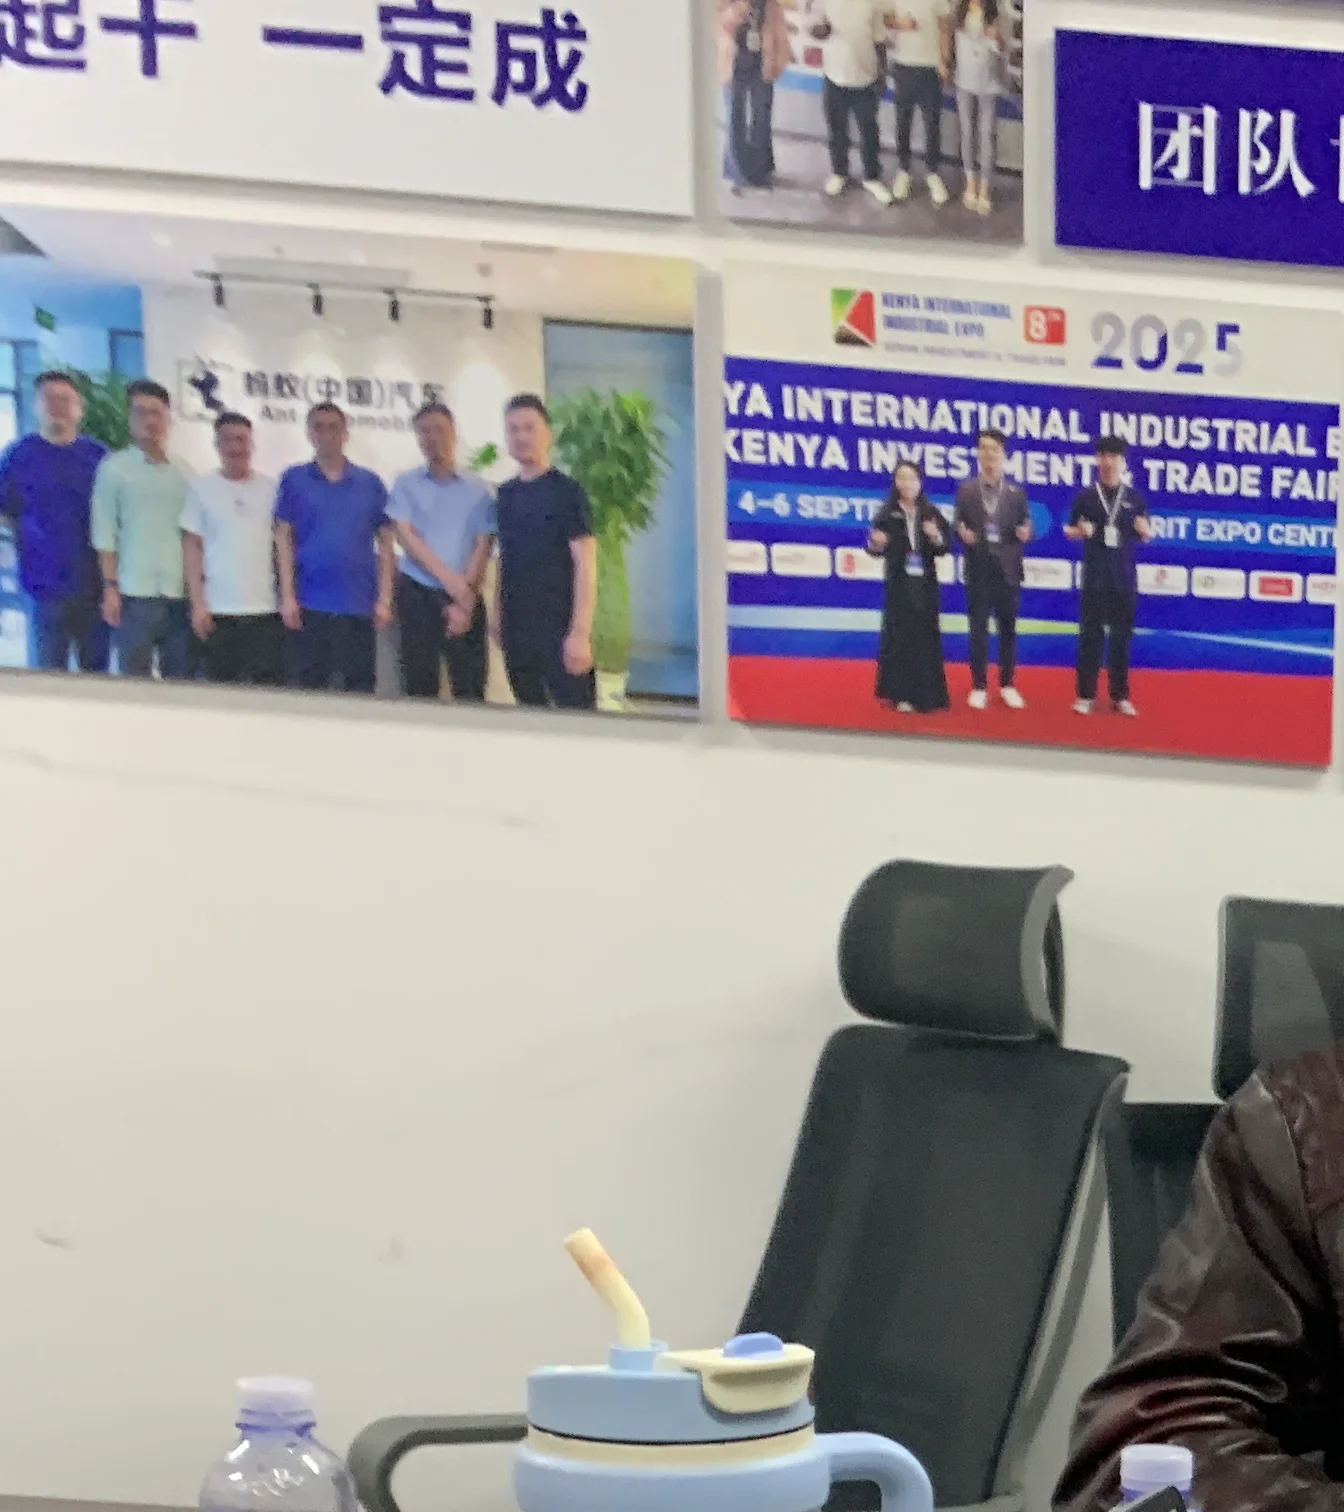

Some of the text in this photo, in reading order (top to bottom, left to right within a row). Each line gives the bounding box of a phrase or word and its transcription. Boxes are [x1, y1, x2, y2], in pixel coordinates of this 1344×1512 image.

[262, 0, 589, 113] 一定成
[1089, 310, 1244, 377] 2025
[780, 383, 1091, 444] INTERNATIONAL
[1099, 410, 1317, 458] INDUSTRIAL
[857, 437, 1097, 488] INVESMENT
[1143, 457, 1263, 498] TRADE
[1196, 517, 1262, 545] EXPO
[1266, 523, 1337, 550] CENT
